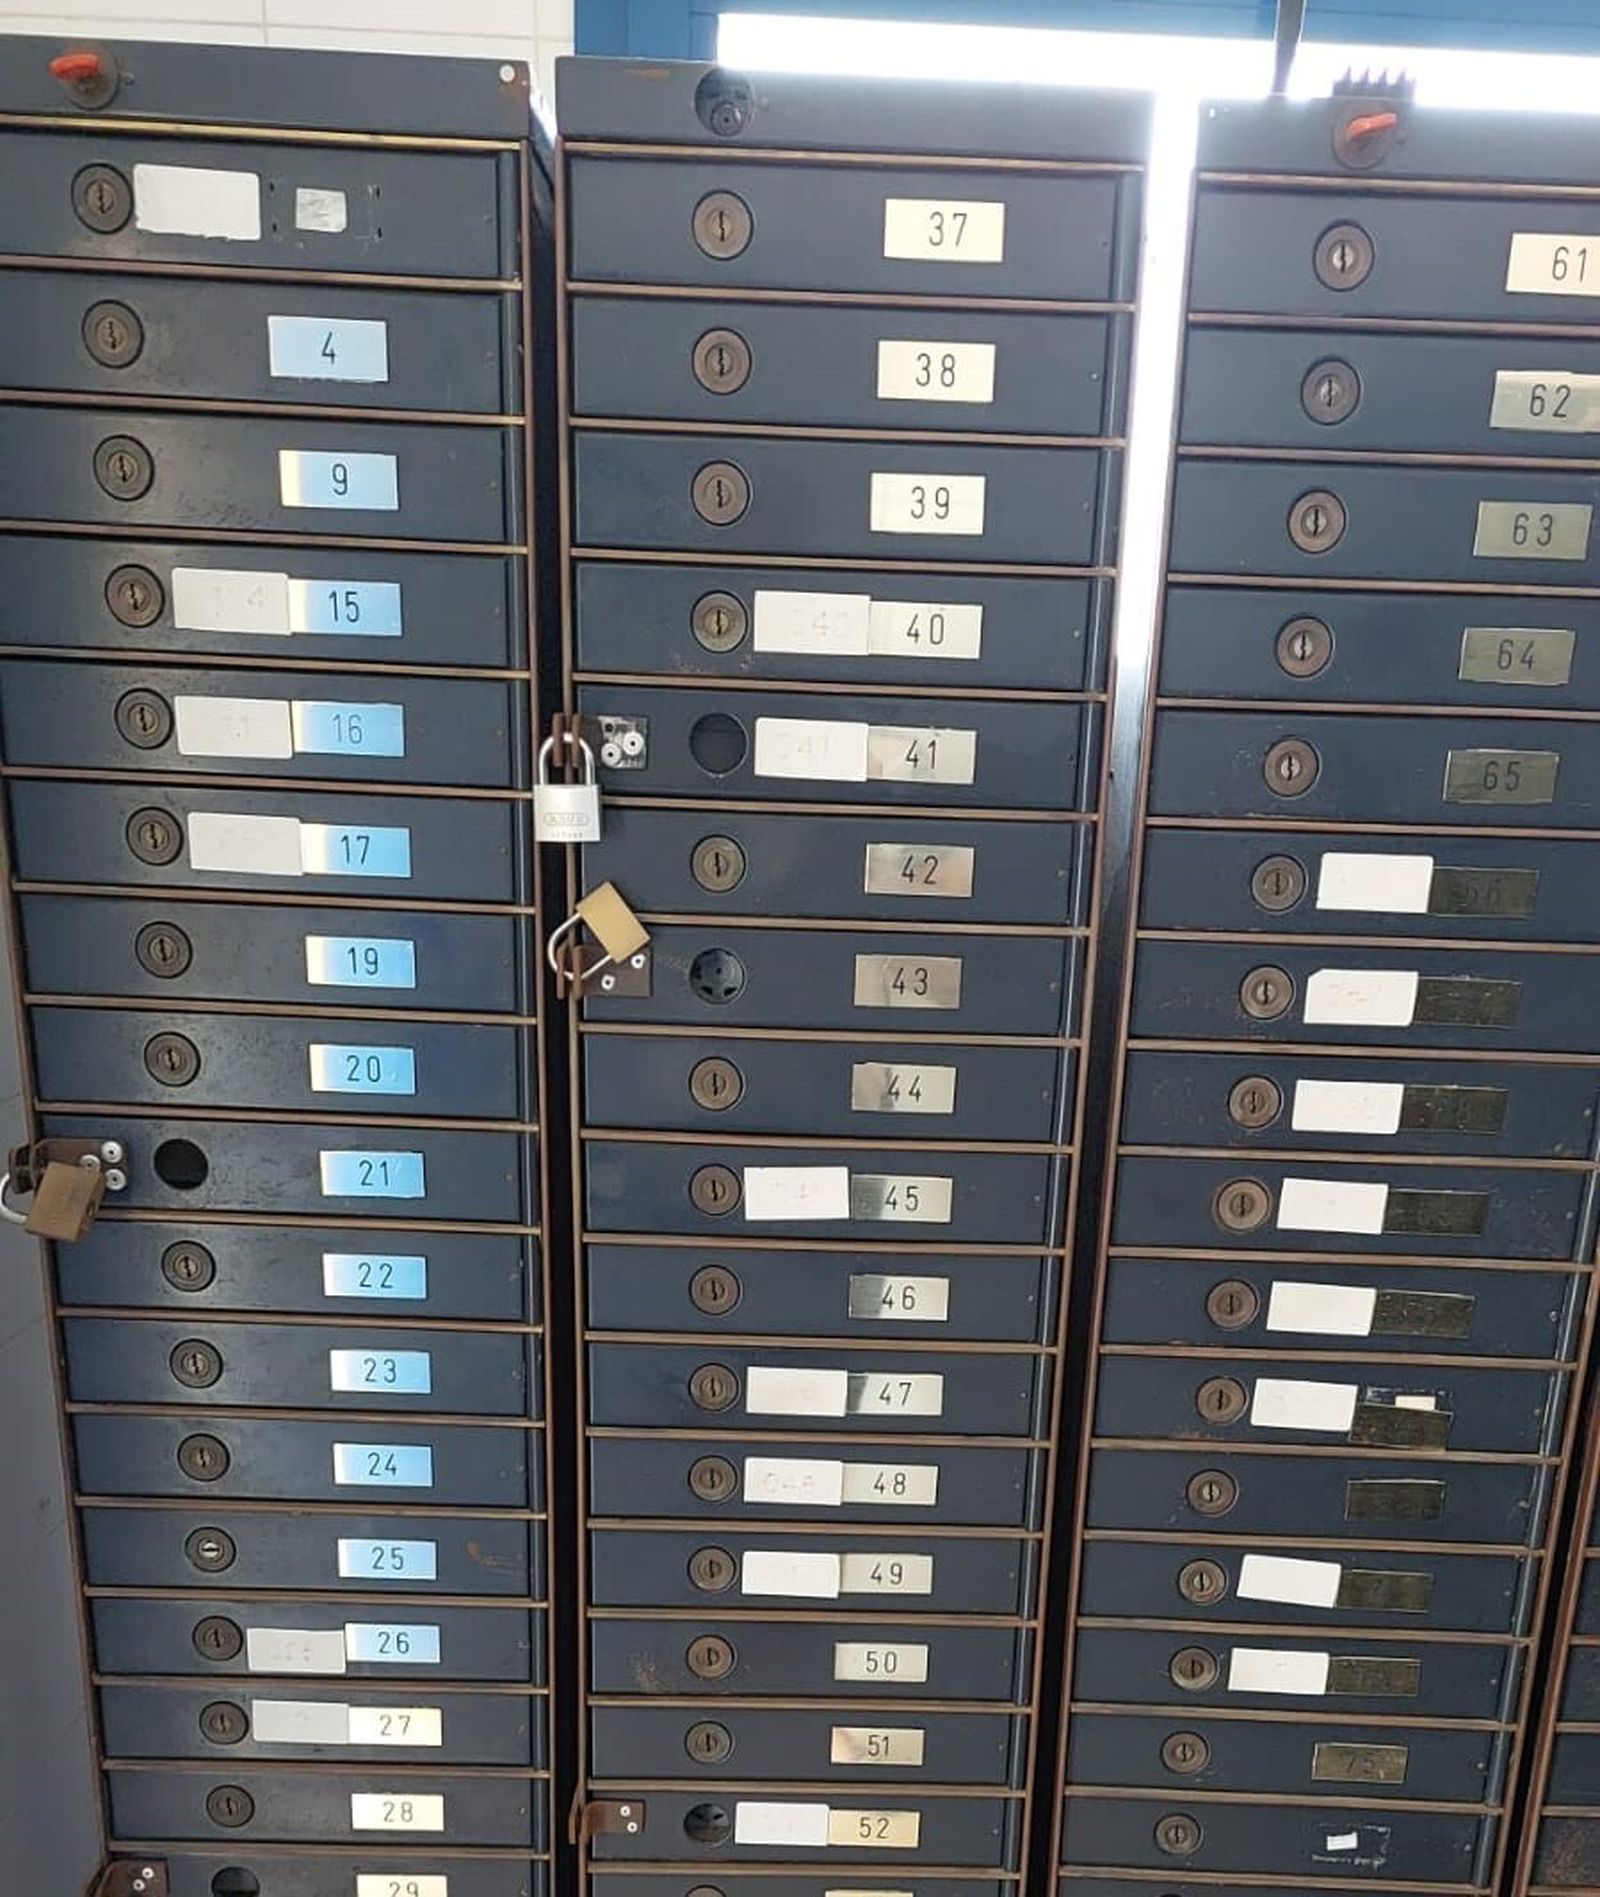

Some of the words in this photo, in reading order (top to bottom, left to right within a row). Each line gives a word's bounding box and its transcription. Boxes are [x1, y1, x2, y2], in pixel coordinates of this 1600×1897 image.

[929, 211, 968, 247] 37
[1551, 245, 1587, 282] 61
[321, 331, 336, 364] 4
[915, 352, 956, 388] 38
[1529, 383, 1571, 419] 62
[332, 463, 348, 496] 9
[910, 485, 950, 520] 39
[1512, 512, 1554, 547] 63
[329, 590, 360, 623] 15
[906, 613, 945, 646] 40
[1497, 638, 1535, 670] 64
[332, 713, 363, 745] 16
[905, 739, 937, 769] 41
[1483, 760, 1521, 792] 65
[340, 834, 370, 865] 17
[901, 854, 939, 885] 42
[347, 946, 379, 976] 19
[892, 967, 928, 996] 43
[346, 1054, 381, 1083] 20
[887, 1074, 922, 1103] 44
[358, 1159, 389, 1187] 21
[884, 1185, 919, 1212] 45
[358, 1262, 393, 1289] 22
[881, 1284, 916, 1311] 46
[363, 1357, 397, 1384] 23
[879, 1381, 912, 1406] 47
[367, 1451, 397, 1477] 24
[873, 1472, 907, 1496] 48
[371, 1546, 404, 1571] 25
[870, 1562, 903, 1586] 49
[377, 1631, 410, 1654] 26
[865, 1650, 898, 1674] 50
[379, 1714, 411, 1737] 27
[867, 1734, 890, 1757] 51
[383, 1801, 414, 1823] 28
[859, 1816, 890, 1840] 52
